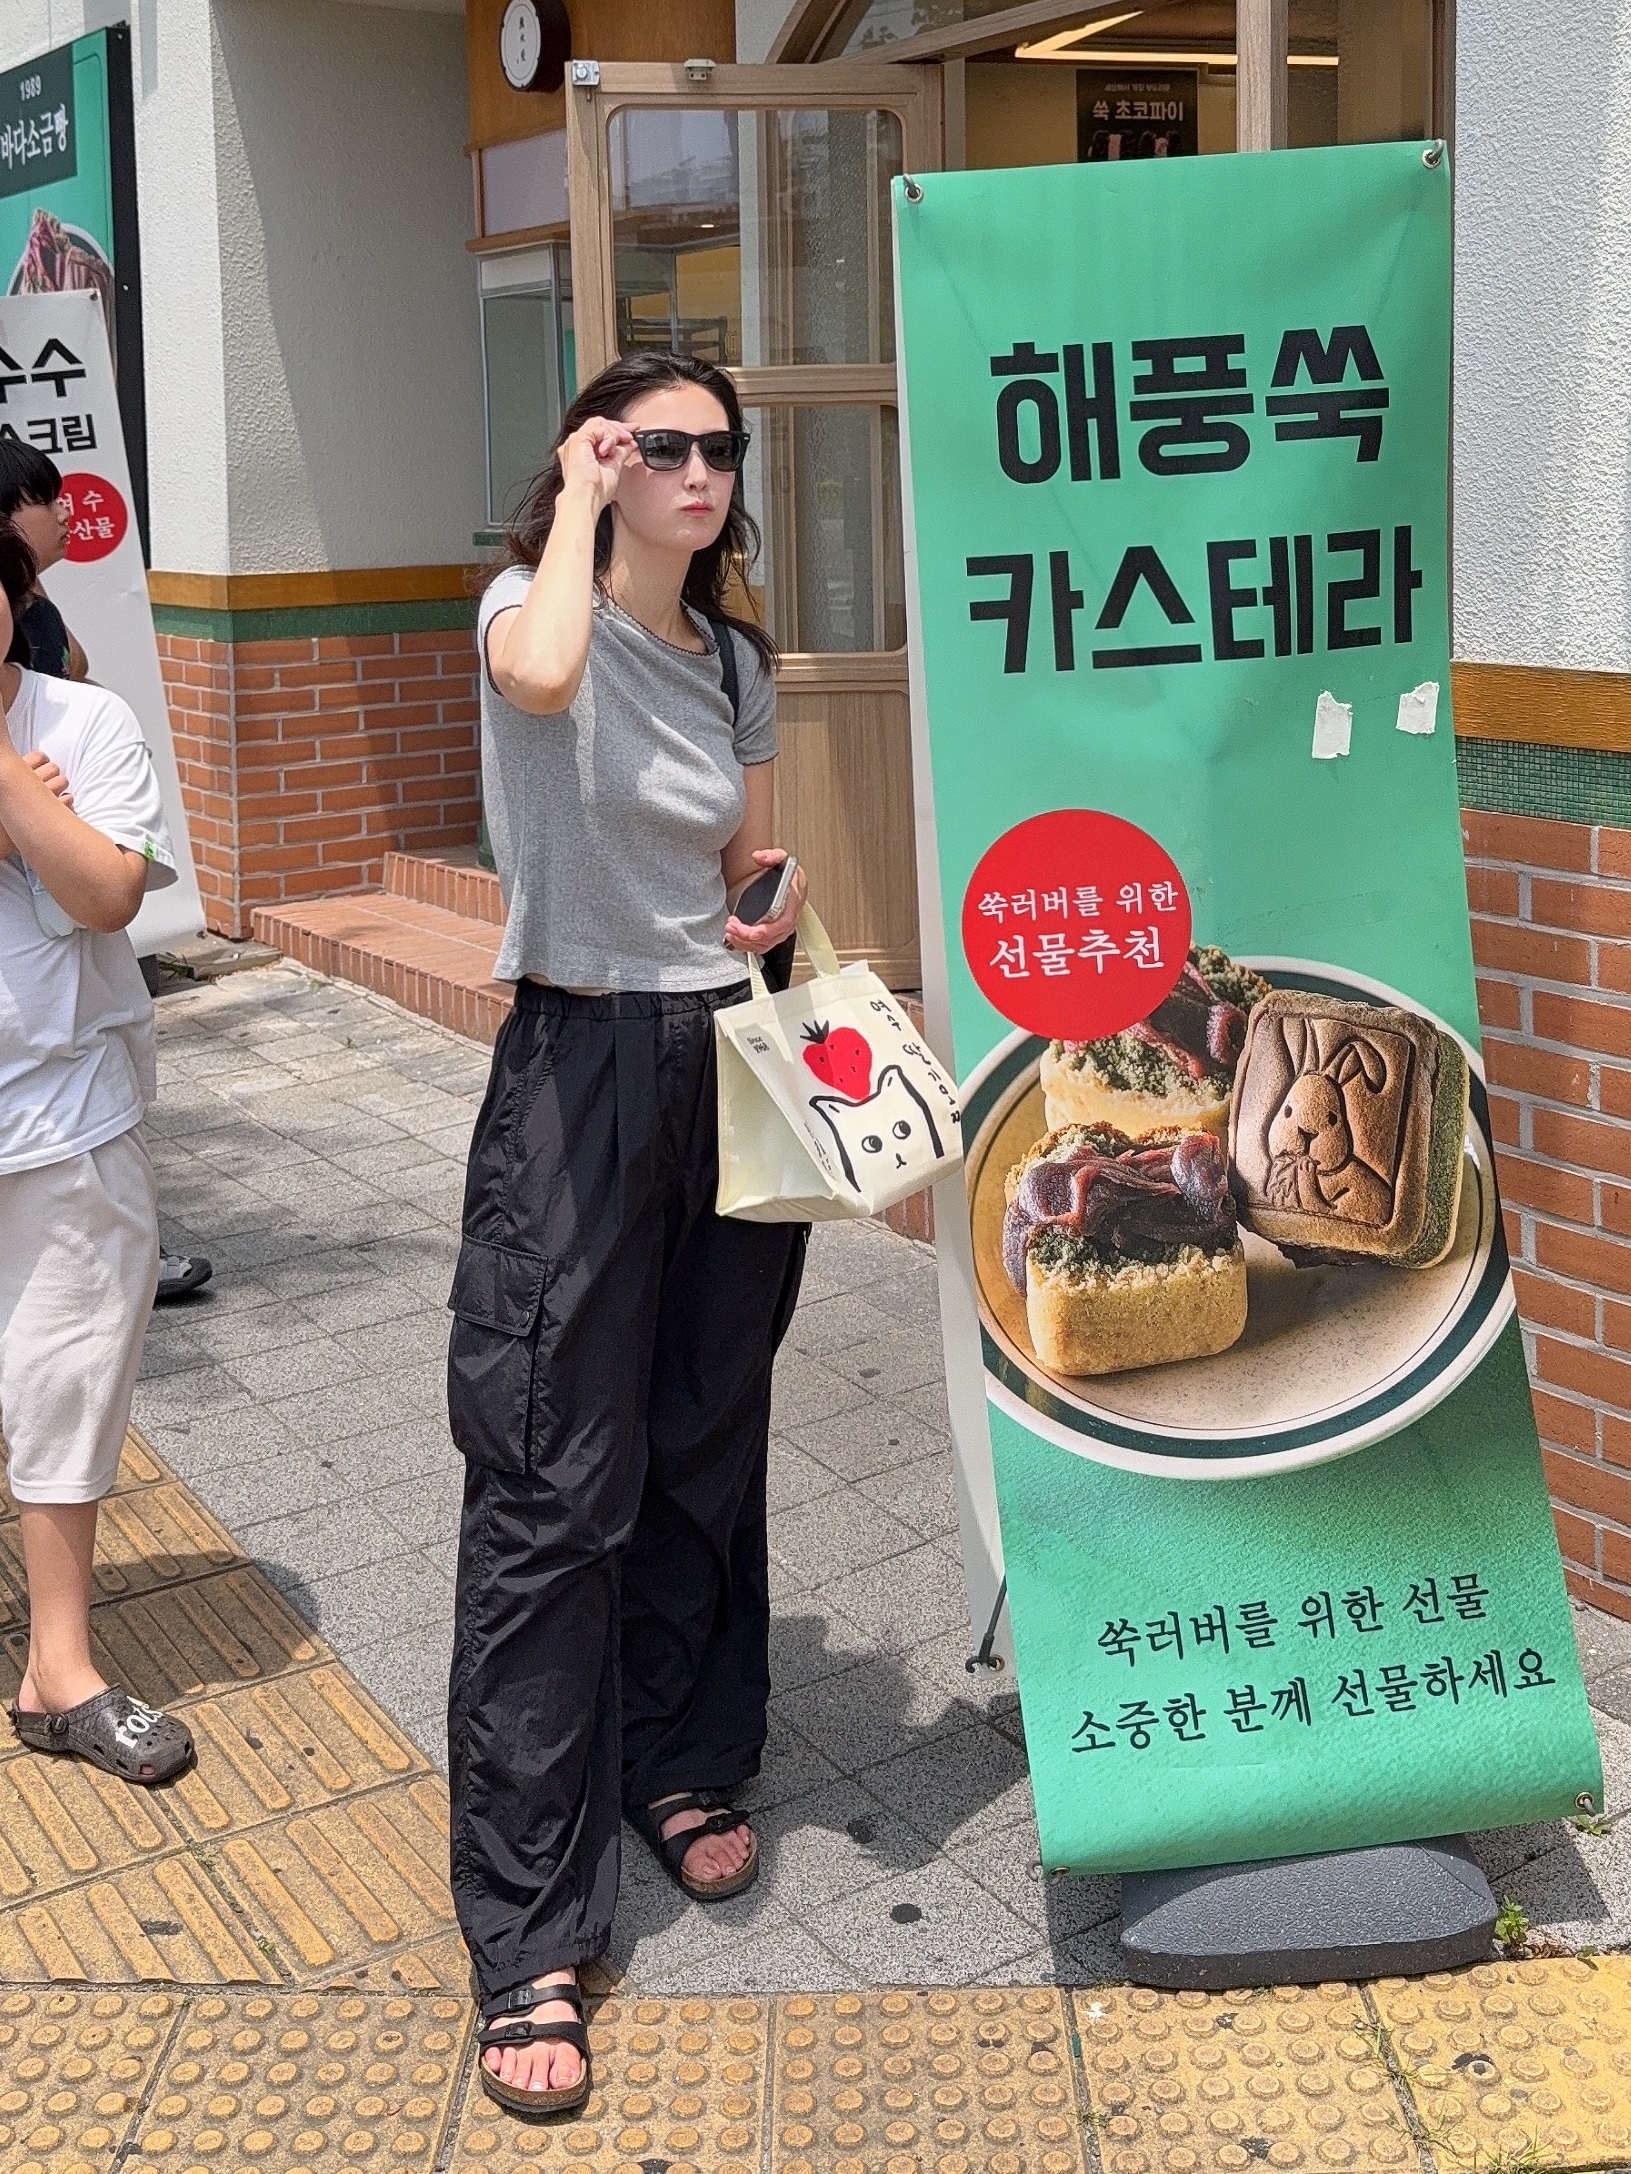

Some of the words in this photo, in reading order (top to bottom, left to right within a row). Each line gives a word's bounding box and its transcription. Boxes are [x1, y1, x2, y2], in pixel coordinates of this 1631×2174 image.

[21, 75, 41, 101] 1989
[1092, 100, 1110, 121] 쑥
[1115, 99, 1184, 121] 초코파이
[990, 325, 1390, 484] 해풍쑥
[66, 516, 115, 545] 산물
[966, 525, 1423, 674] 카스테라
[978, 886, 1103, 924] 쑥러버를
[1116, 880, 1179, 914] 위한
[989, 926, 1165, 978] 선물추천
[1097, 1600, 1278, 1667] 쑥러버를
[1298, 1584, 1385, 1640] 위한
[1402, 1573, 1490, 1625] 선물
[1070, 1691, 1206, 1754] 소중한
[1223, 1676, 1312, 1733] 분께
[1332, 1647, 1556, 1717] 선물하세요
